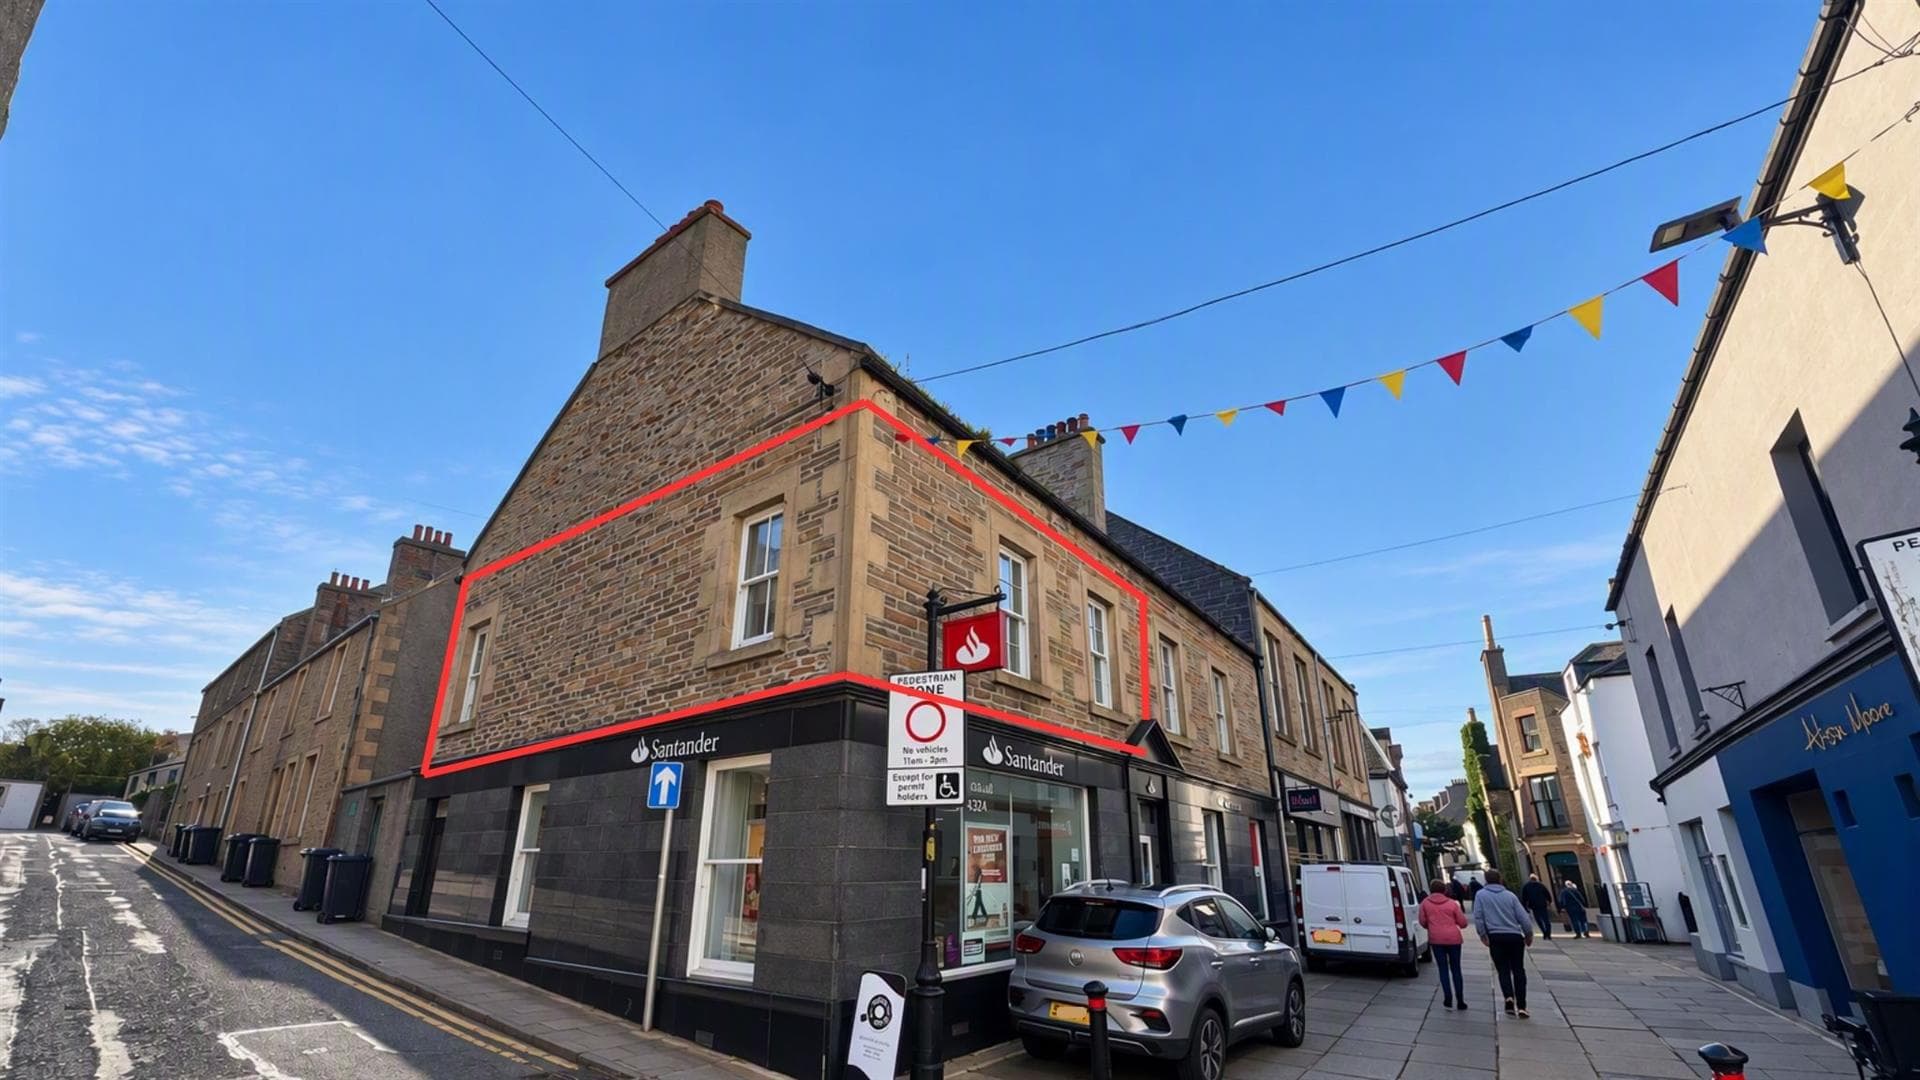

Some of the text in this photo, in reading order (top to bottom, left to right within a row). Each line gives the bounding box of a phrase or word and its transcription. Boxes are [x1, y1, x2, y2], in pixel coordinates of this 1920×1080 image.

[897, 673, 957, 685] PEDESTRIAN
[1844, 692, 1894, 736] Moore
[650, 731, 720, 760] Santander
[902, 745, 949, 755] No vehicles
[903, 757, 923, 766] 11am
[1005, 745, 1065, 777] Santander
[892, 772, 934, 783] Except for
[897, 783, 925, 792] permit
[896, 793, 929, 801] holders
